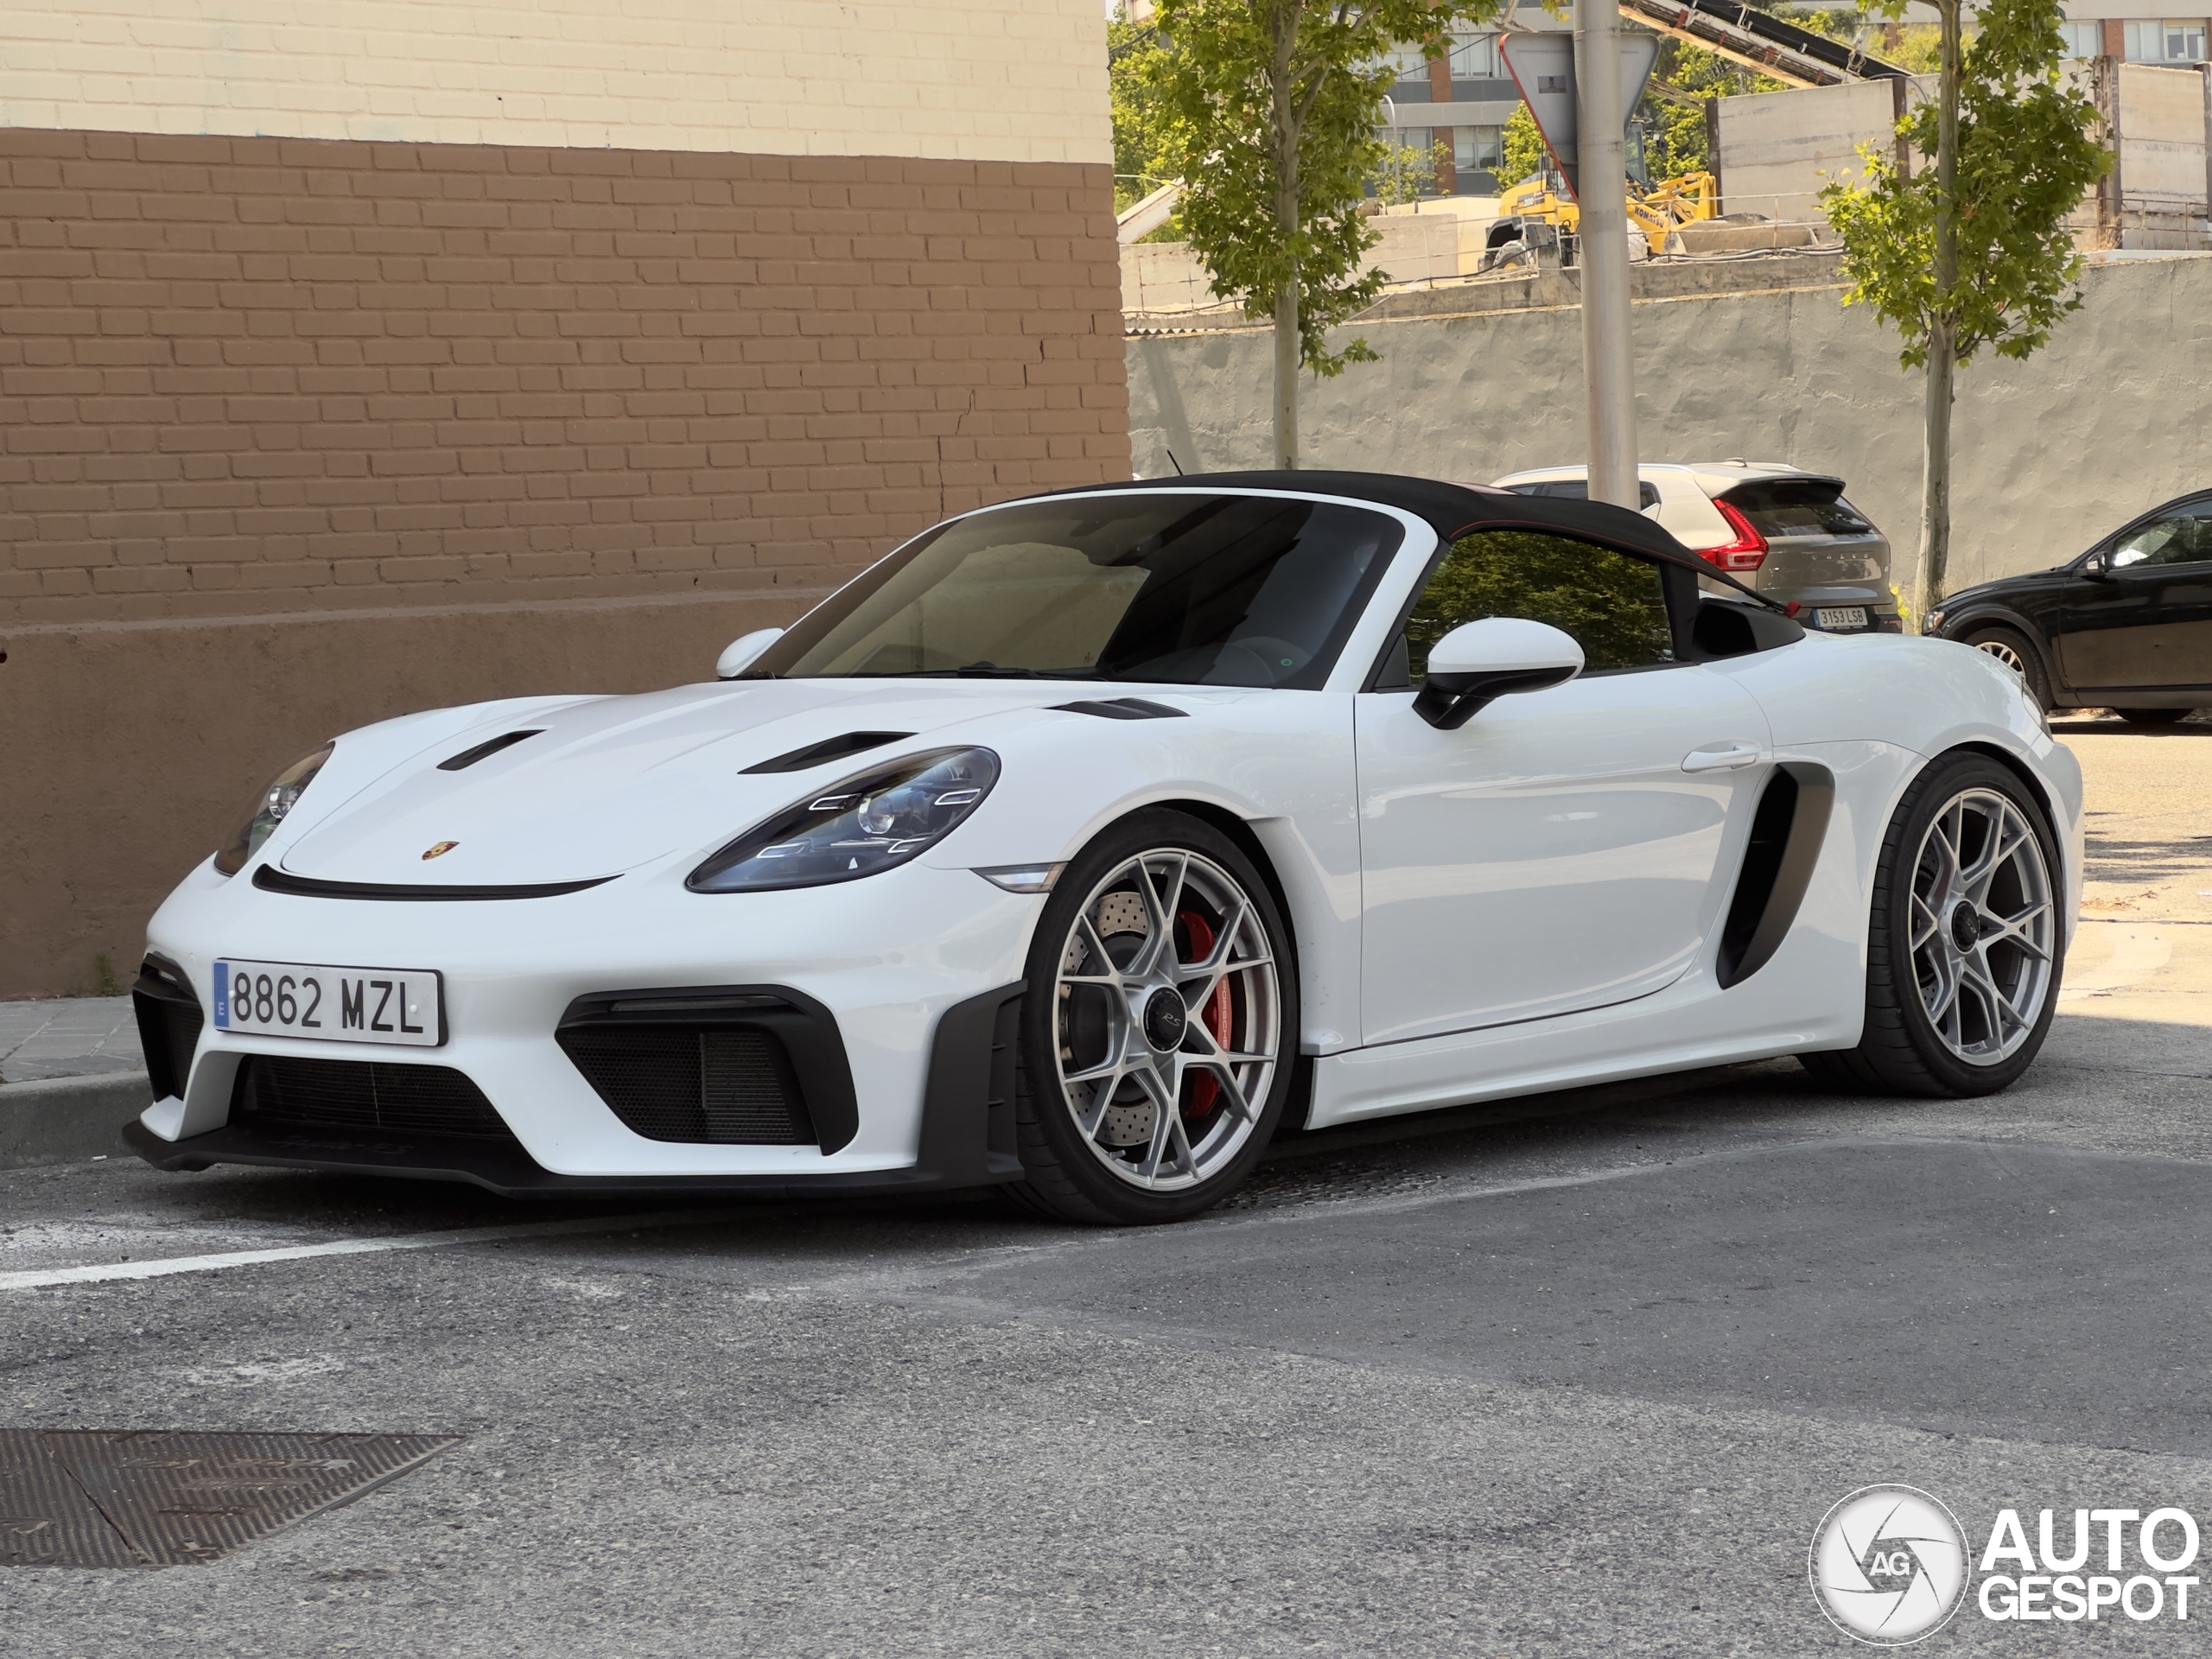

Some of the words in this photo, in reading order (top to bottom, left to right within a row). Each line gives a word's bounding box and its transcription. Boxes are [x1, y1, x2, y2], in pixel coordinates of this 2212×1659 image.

[1635, 206, 1664, 228] KOMATSU
[1821, 611, 1845, 624] 3153
[1847, 610, 1864, 623] LSB
[218, 1001, 225, 1016] E
[233, 971, 321, 1028] 8862
[340, 978, 423, 1034] MZL
[1162, 1012, 1181, 1027] RS
